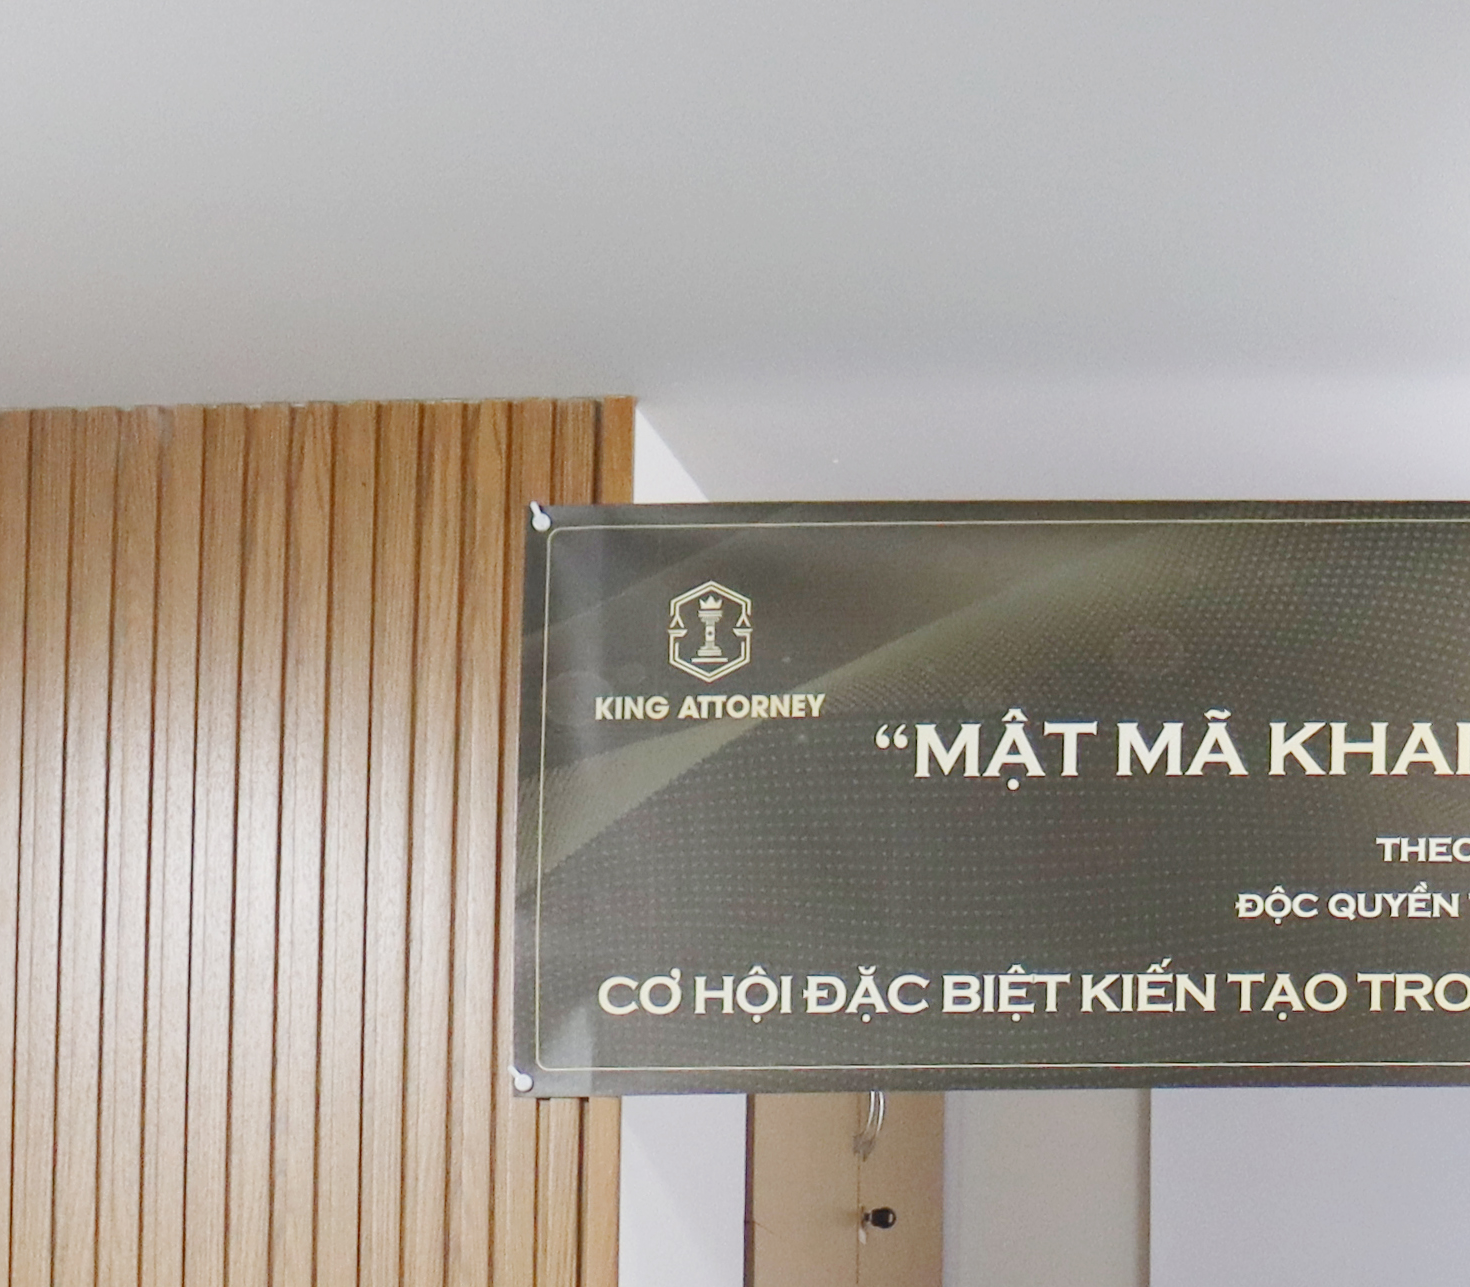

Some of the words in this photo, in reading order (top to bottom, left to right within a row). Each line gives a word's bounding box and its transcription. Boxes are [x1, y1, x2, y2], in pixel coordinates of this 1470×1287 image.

[595, 695, 670, 720] KING
[677, 692, 826, 719] ATTORNEY
[1115, 708, 1252, 777] MÃ
[1235, 886, 1320, 925] ĐỘC
[1327, 881, 1462, 924] QUYỀN
[598, 968, 683, 1015] CƠ
[693, 966, 793, 1024] HỘI
[801, 965, 931, 1024] ĐẶC
[941, 964, 1071, 1023] BIỆT
[1080, 959, 1217, 1014] KIẾN
[1226, 972, 1349, 1021] TẠO
